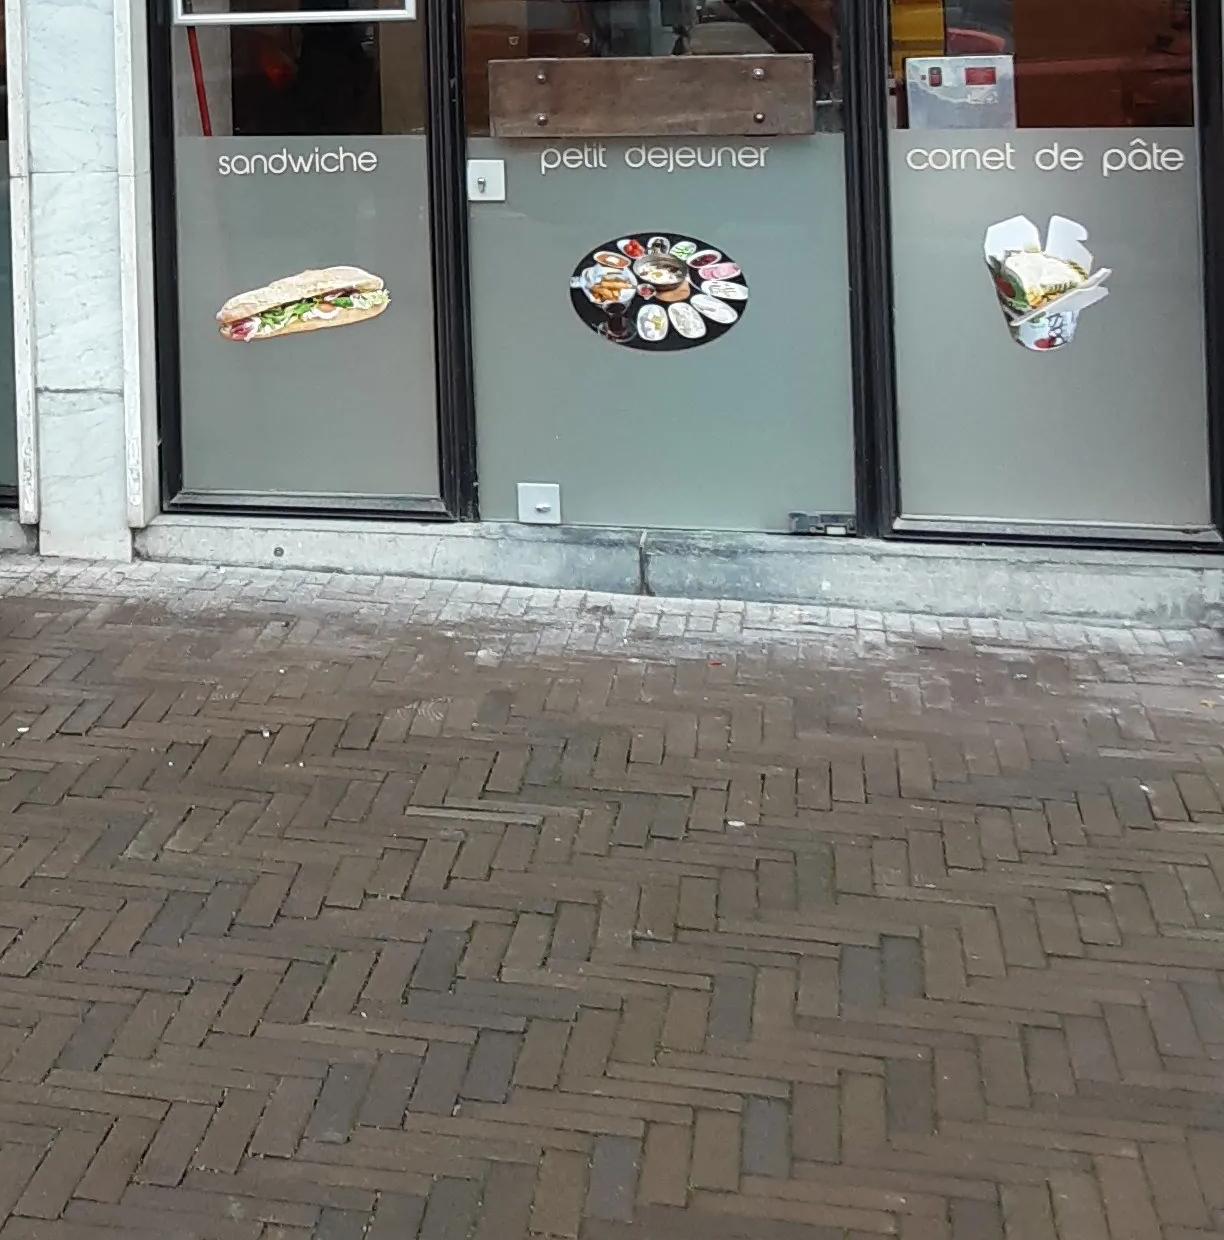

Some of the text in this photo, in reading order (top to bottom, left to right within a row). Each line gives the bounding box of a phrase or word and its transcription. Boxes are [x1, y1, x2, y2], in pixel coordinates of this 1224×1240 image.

[218, 146, 378, 176] sandwiche
[539, 143, 769, 176] petit dejeuner
[906, 138, 1184, 177] cornet de pâte
